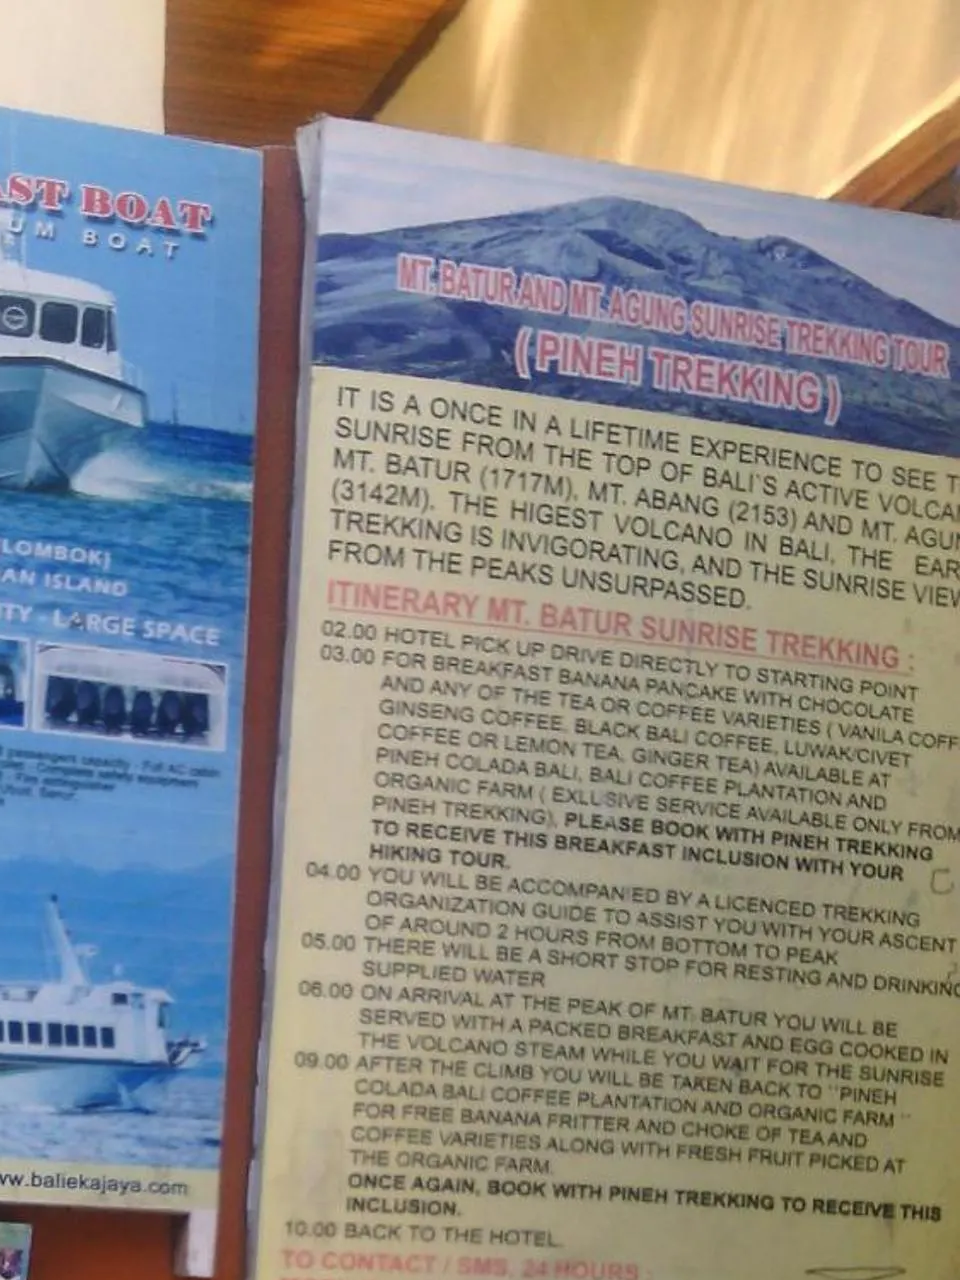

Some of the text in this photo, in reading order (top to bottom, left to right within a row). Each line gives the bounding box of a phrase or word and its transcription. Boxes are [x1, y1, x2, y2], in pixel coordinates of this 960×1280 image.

[80, 182, 213, 233] BOAT
[82, 229, 182, 259] BOAT
[516, 271, 568, 315] AND
[610, 286, 687, 335] AGUNG
[690, 302, 782, 348] SUNRISE
[787, 318, 891, 367] TREKKING
[893, 334, 950, 377] TOUR
[335, 416, 450, 452] SUNRISE
[462, 434, 533, 464] FROM
[543, 445, 592, 472] THE
[601, 453, 651, 480] TOP
[660, 461, 693, 485] OF
[785, 478, 868, 509] ACTIVE
[337, 387, 935, 491] IT IS A ONCE IN A LIFETIME EXPERIENCE TO SEE
[385, 454, 470, 486] BATUR
[634, 487, 719, 519] ABANG
[728, 499, 797, 529] (2153)
[803, 509, 852, 536] AND
[329, 509, 462, 545] TREKKING
[471, 527, 492, 549] IS
[692, 555, 741, 581] AND
[749, 562, 794, 587] THE
[803, 569, 904, 601] SUNRISE
[449, 493, 497, 521] THE
[510, 501, 603, 534] HIGEST
[613, 515, 732, 551] VOLCANO
[745, 532, 767, 555] IN
[847, 545, 892, 571] THE
[44, 573, 129, 598] ISLAND
[328, 540, 404, 569] FROM
[412, 550, 461, 576] THE
[471, 557, 553, 587] PEAKS
[52, 608, 137, 636] LARGE
[142, 619, 222, 646] SPACE
[327, 579, 899, 671] ITINERARY MT. BATUR SUNRISE TREKKING
[320, 645, 912, 723] 03.00 FOR BREAKFAST BANANA PANCAKE WITH CHOCOLATE
[322, 621, 918, 700] 02.00 HOTEL PICK UP DRIVE DIRECTLY TO STARTING POINT
[369, 844, 441, 864] HIKING
[371, 820, 903, 880] TO RECEIVE THIS BREAKFAST INCLUSION WITH YOUR
[372, 796, 435, 816] PINEH
[564, 813, 644, 835] PLEASE
[651, 821, 709, 840] BOOK
[715, 827, 764, 845] WITH
[771, 832, 829, 851] PINEH
[835, 838, 932, 860] TREKKING
[347, 1172, 405, 1191] ONCE
[487, 1180, 546, 1199] BOOK
[552, 1184, 602, 1202] WITH
[609, 1187, 667, 1205] PINEH
[675, 1191, 774, 1211] TREKKING
[781, 1197, 806, 1213] TO
[812, 1198, 894, 1218] RECEIVE
[900, 1203, 941, 1221] THIS
[285, 1220, 337, 1237] 10.00
[344, 1223, 401, 1240] BACK
[408, 1225, 436, 1241] TO
[443, 1227, 482, 1243] THE
[280, 1248, 314, 1267] TO
[326, 1250, 435, 1273] CONTACT
[521, 1259, 546, 1278] 24
